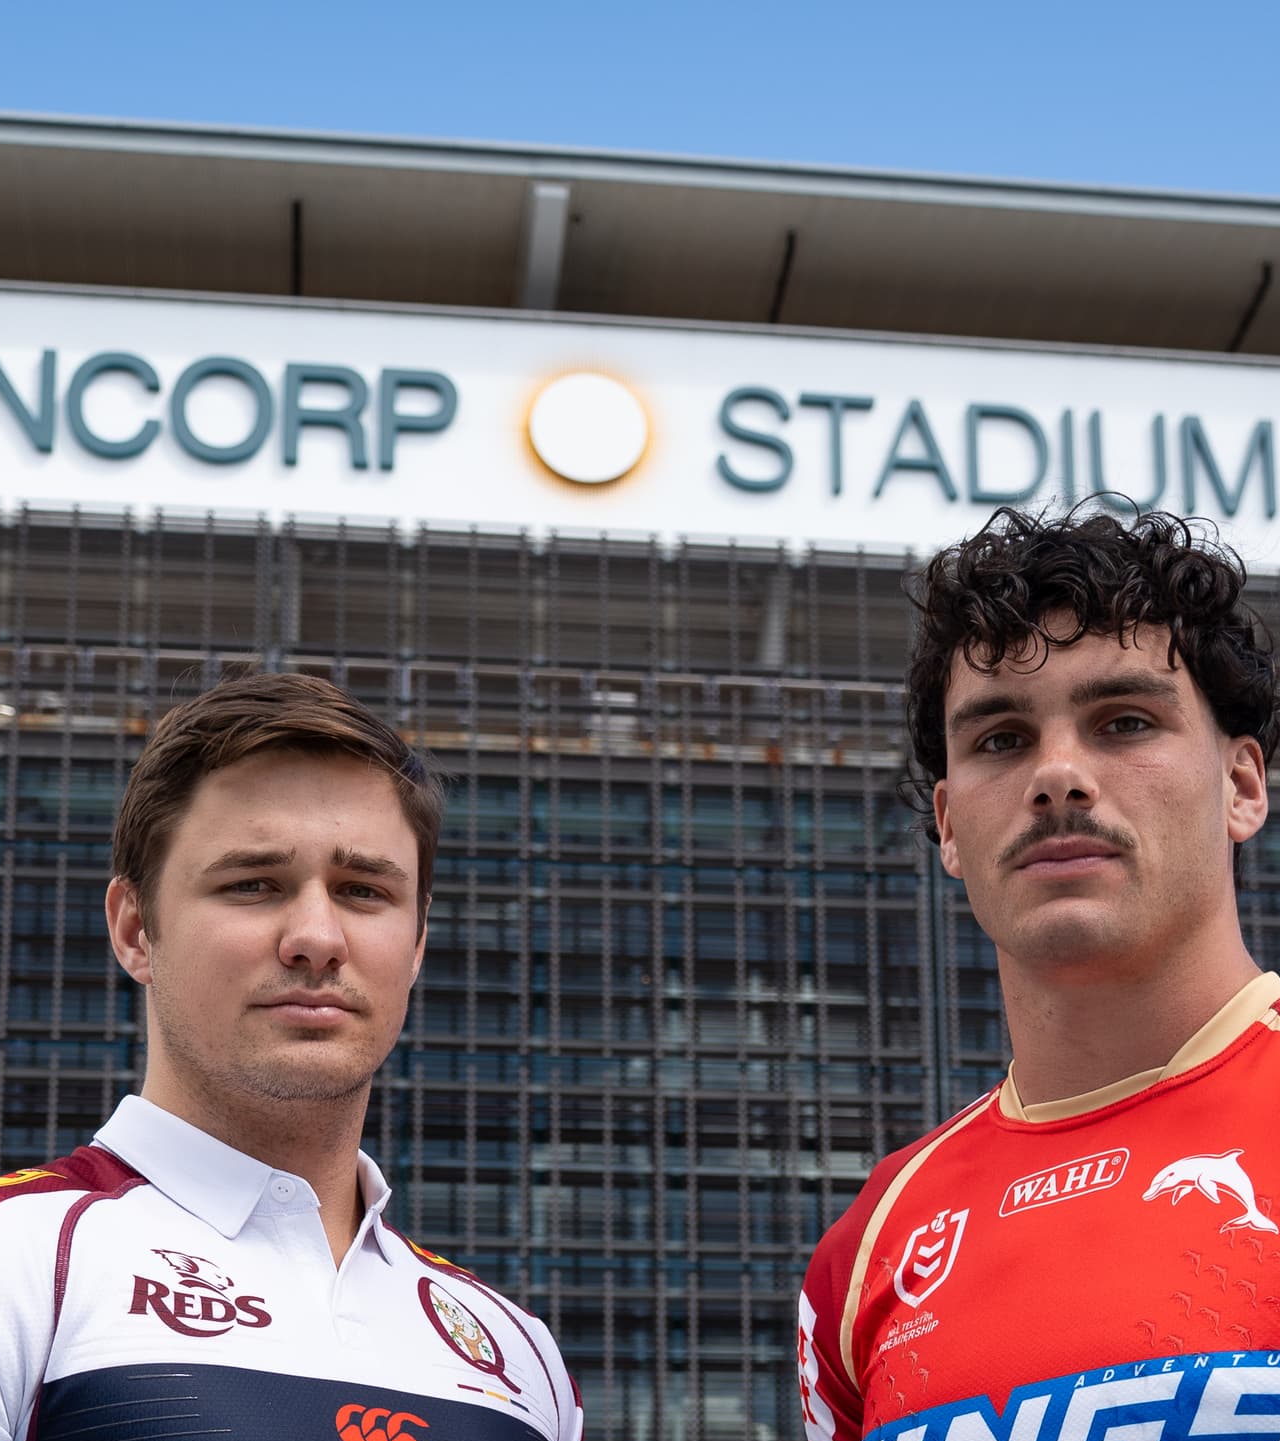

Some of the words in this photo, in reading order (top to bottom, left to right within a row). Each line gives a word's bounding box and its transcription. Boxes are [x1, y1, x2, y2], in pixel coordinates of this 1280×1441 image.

[717, 384, 1277, 520] STADIUM
[127, 1275, 273, 1338] REDS
[878, 1319, 940, 1355] PREMIERSHIP
